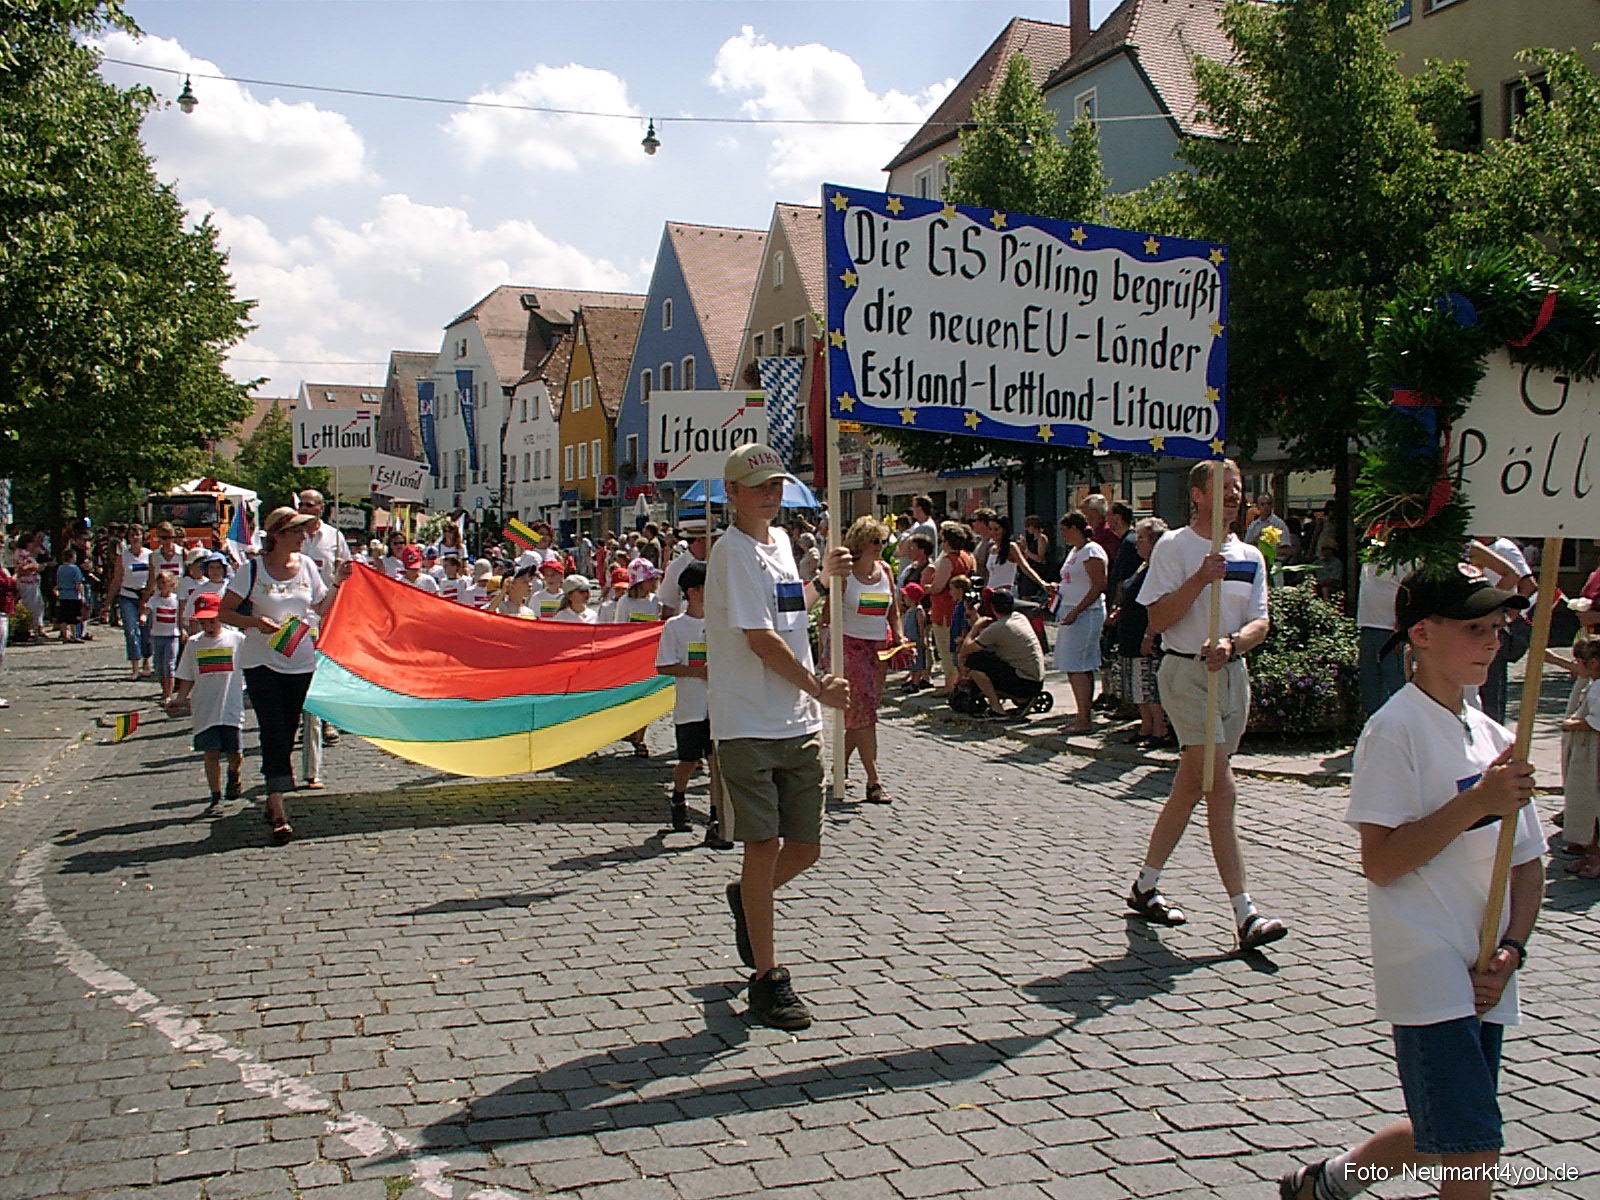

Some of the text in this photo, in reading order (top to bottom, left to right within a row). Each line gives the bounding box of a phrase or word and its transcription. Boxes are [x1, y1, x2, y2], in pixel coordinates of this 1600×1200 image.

[852, 209, 1222, 321] Die GS Pölling begrüßt
[863, 287, 913, 336] die
[300, 422, 372, 450] Lettland
[660, 413, 758, 454] Litauen
[376, 464, 423, 490] Estland
[1458, 428, 1593, 499] Pöll
